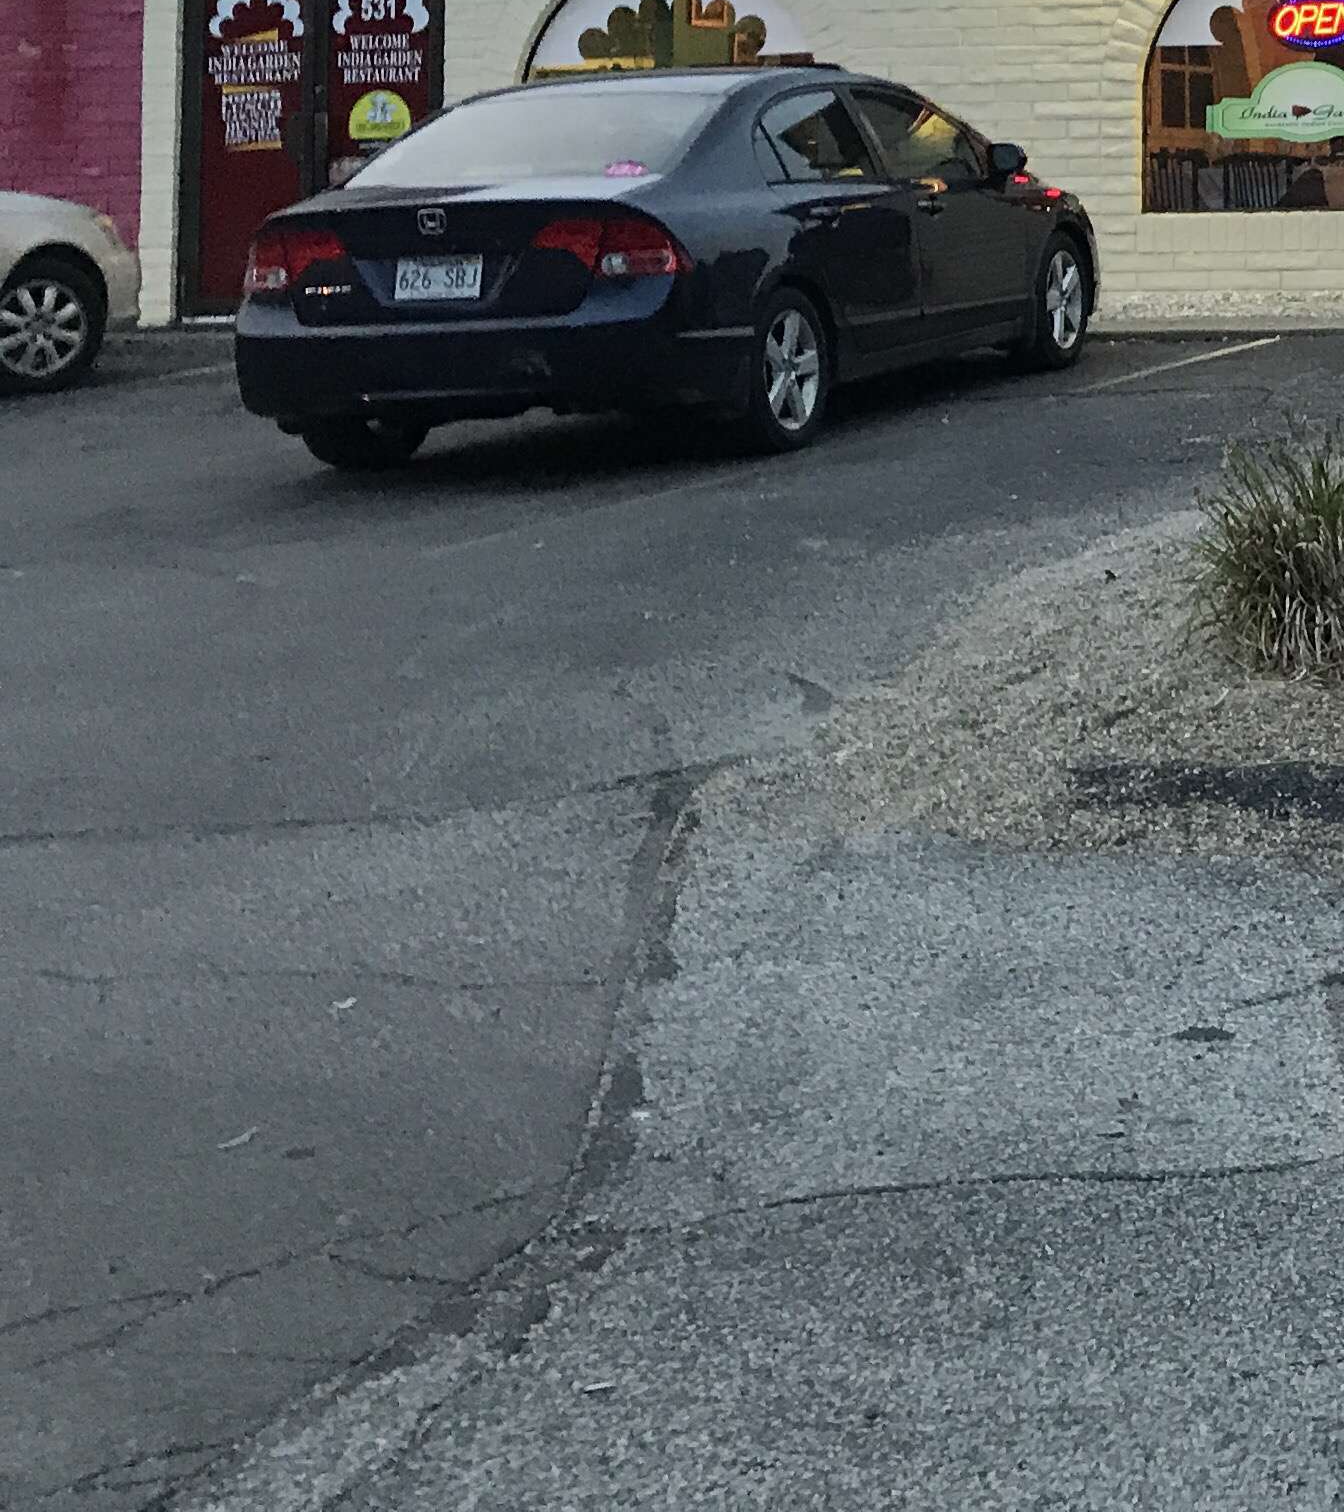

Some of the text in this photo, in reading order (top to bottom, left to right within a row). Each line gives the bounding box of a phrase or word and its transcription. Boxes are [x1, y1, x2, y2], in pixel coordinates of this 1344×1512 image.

[221, 39, 288, 57] WELCOME
[349, 33, 410, 50] WELCOME
[208, 50, 301, 74] INDIA GARDEN
[337, 48, 423, 67] INDIA GARDEN
[214, 69, 299, 85] RESTAURANT
[343, 67, 421, 84] RESTAURANT
[1239, 104, 1287, 120] India
[399, 265, 478, 290] 626 SBJ
